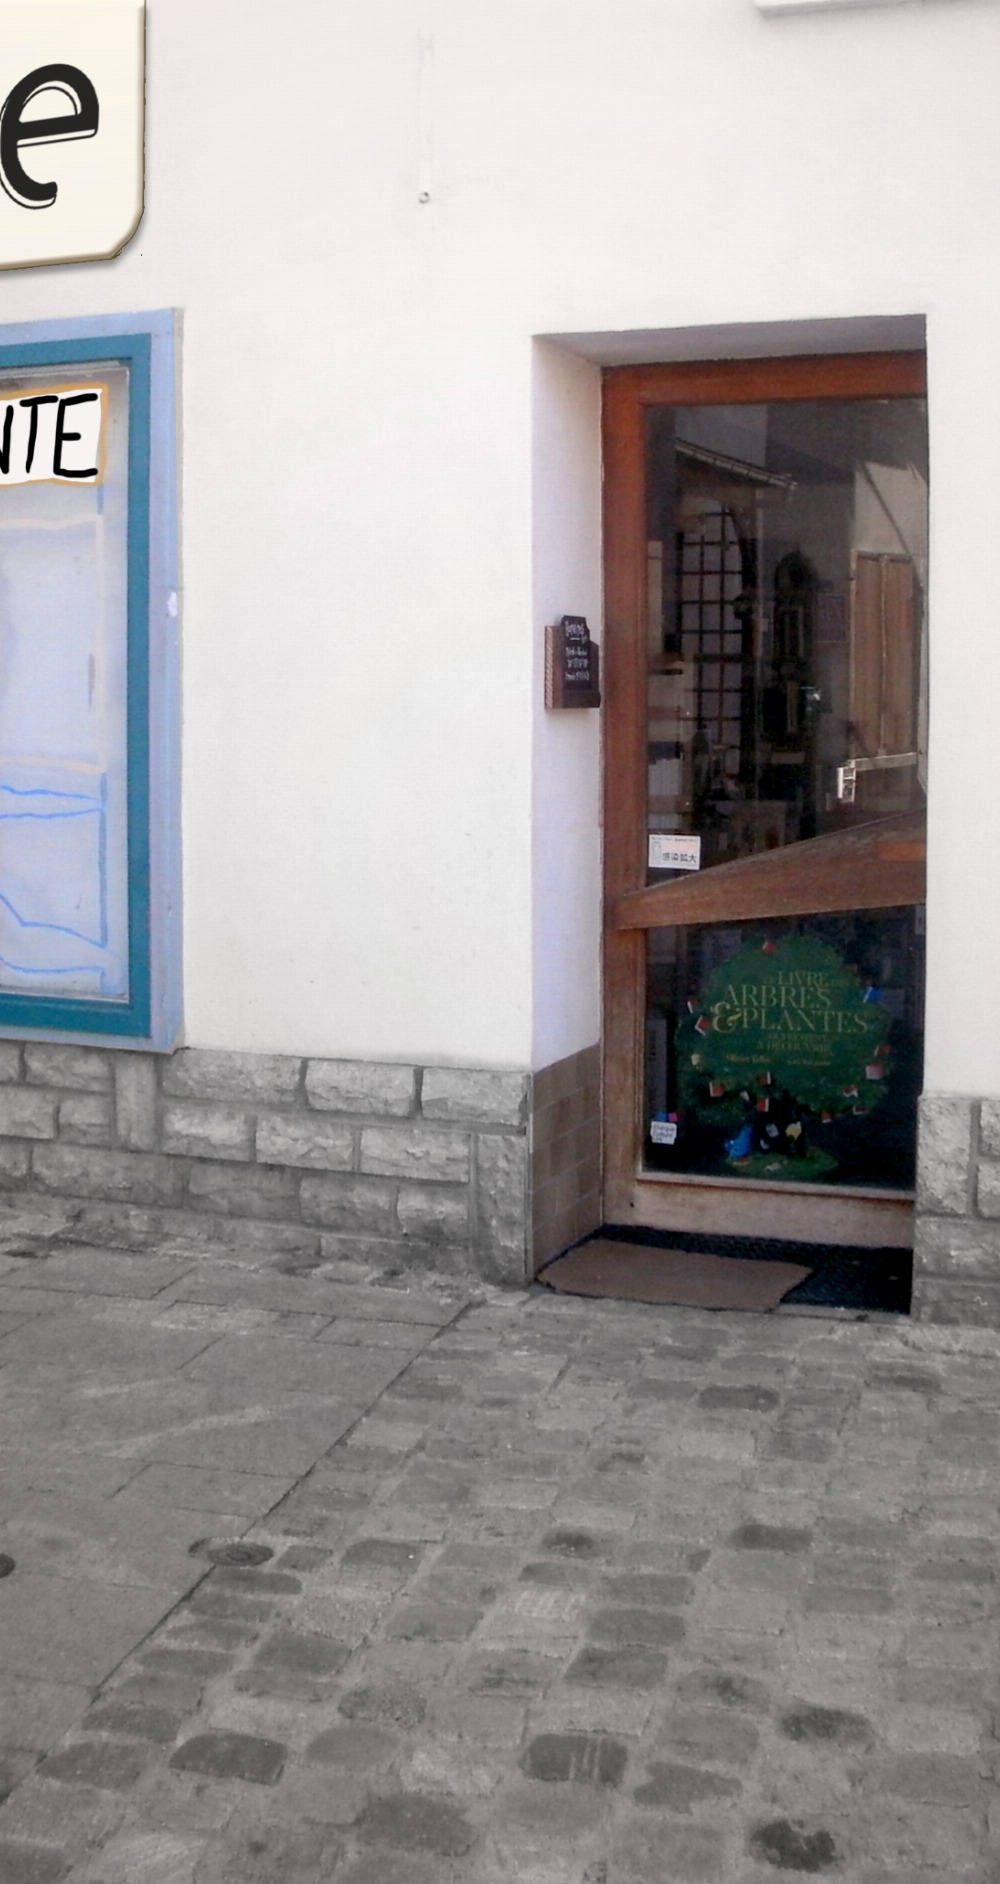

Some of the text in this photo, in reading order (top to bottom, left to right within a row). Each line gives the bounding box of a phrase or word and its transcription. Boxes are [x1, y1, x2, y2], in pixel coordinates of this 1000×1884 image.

[778, 971, 829, 987] LIVRE
[723, 984, 832, 1008] ARBRES
[743, 1007, 868, 1034] PLANTES
